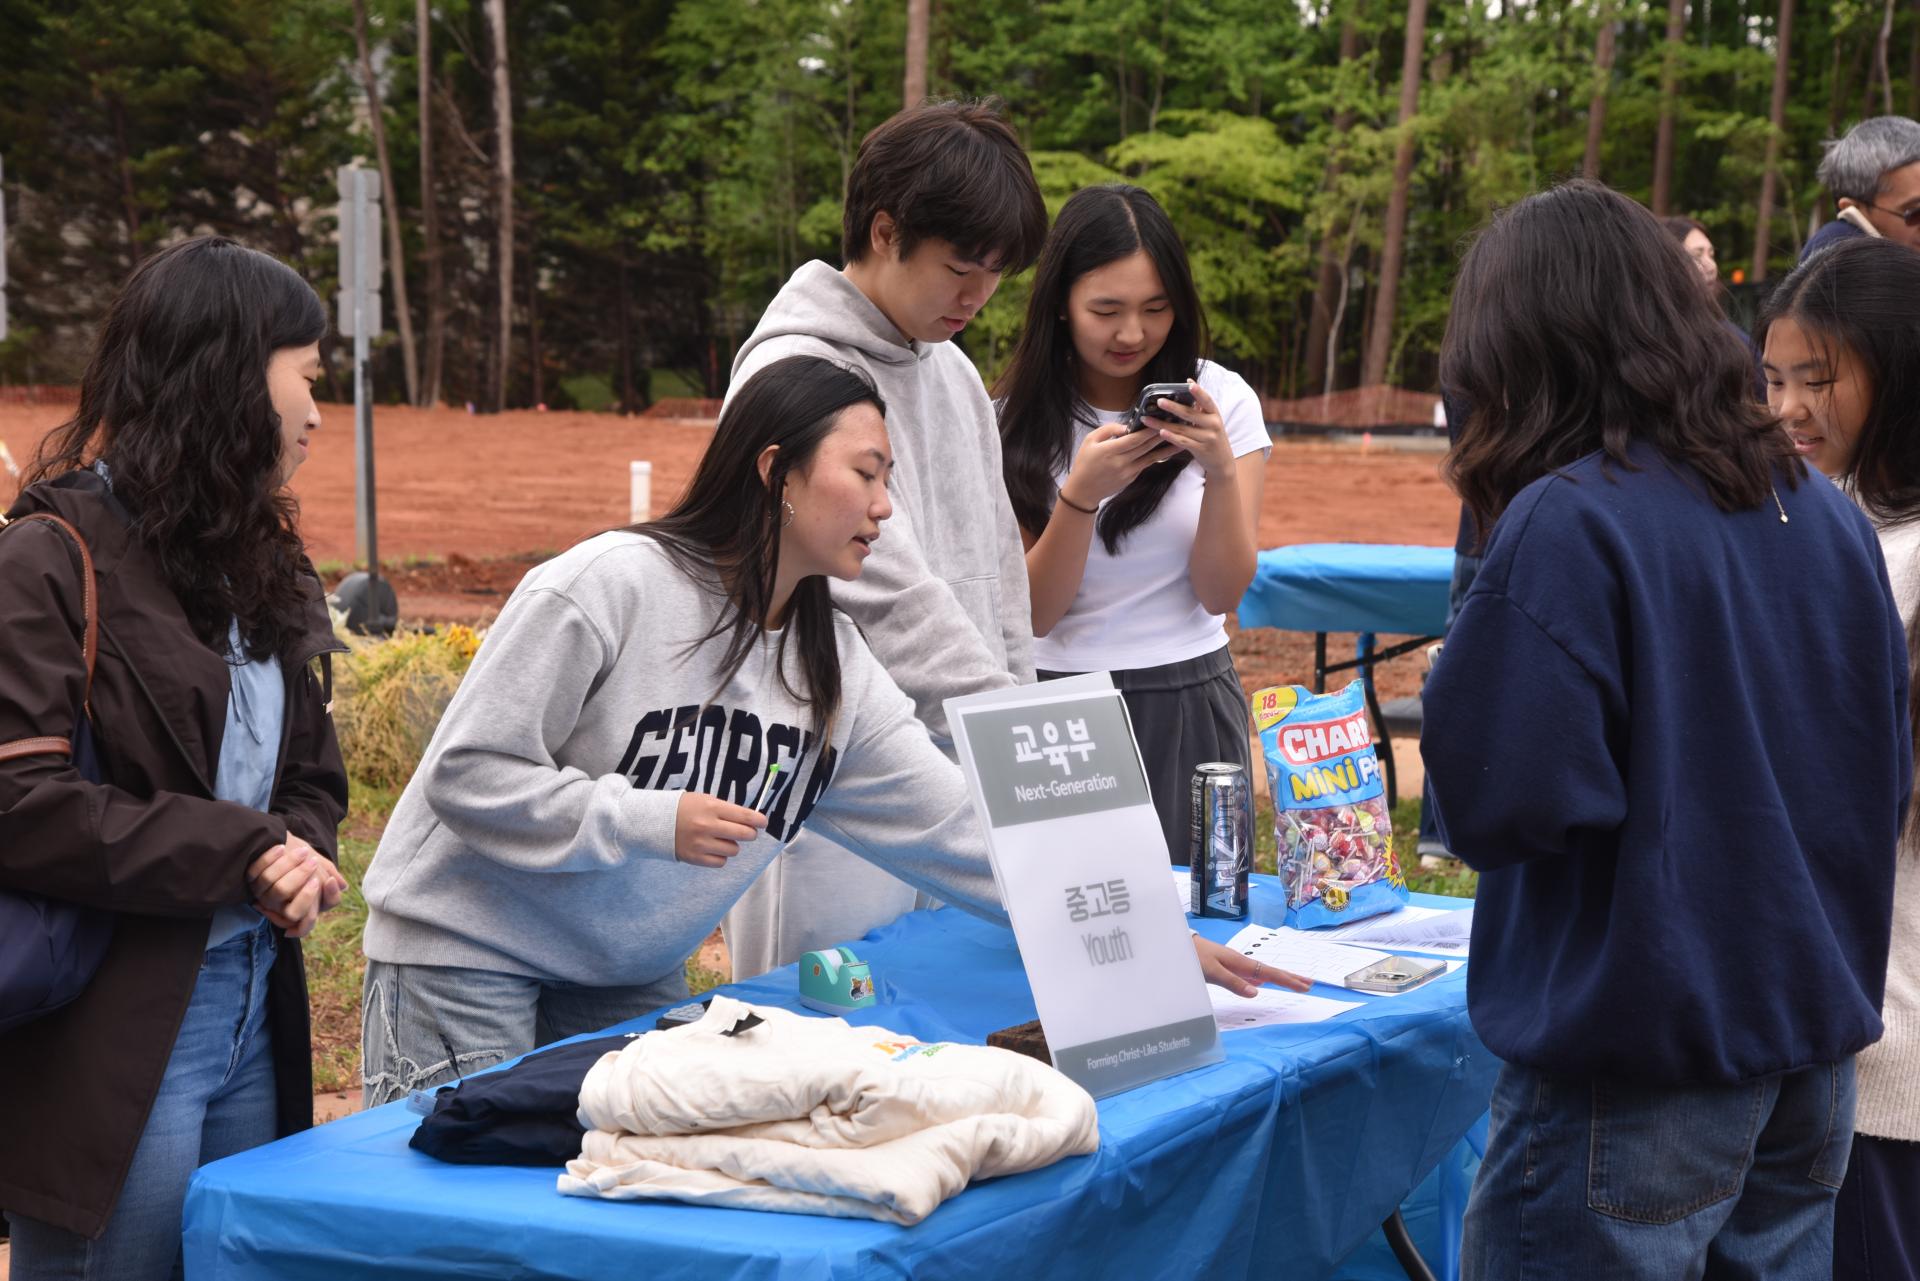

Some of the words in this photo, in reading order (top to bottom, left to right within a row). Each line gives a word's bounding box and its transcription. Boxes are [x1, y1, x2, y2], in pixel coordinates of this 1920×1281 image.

[1262, 692, 1277, 710] 18
[1012, 718, 1096, 775] 교육부
[1014, 773, 1118, 803] Next-Generation
[1064, 878, 1130, 922] 중고등
[1080, 925, 1134, 967] Youth
[1086, 1053, 1118, 1070] Forming
[1118, 1043, 1158, 1063] Christ-Like
[1158, 1036, 1191, 1053] Students
